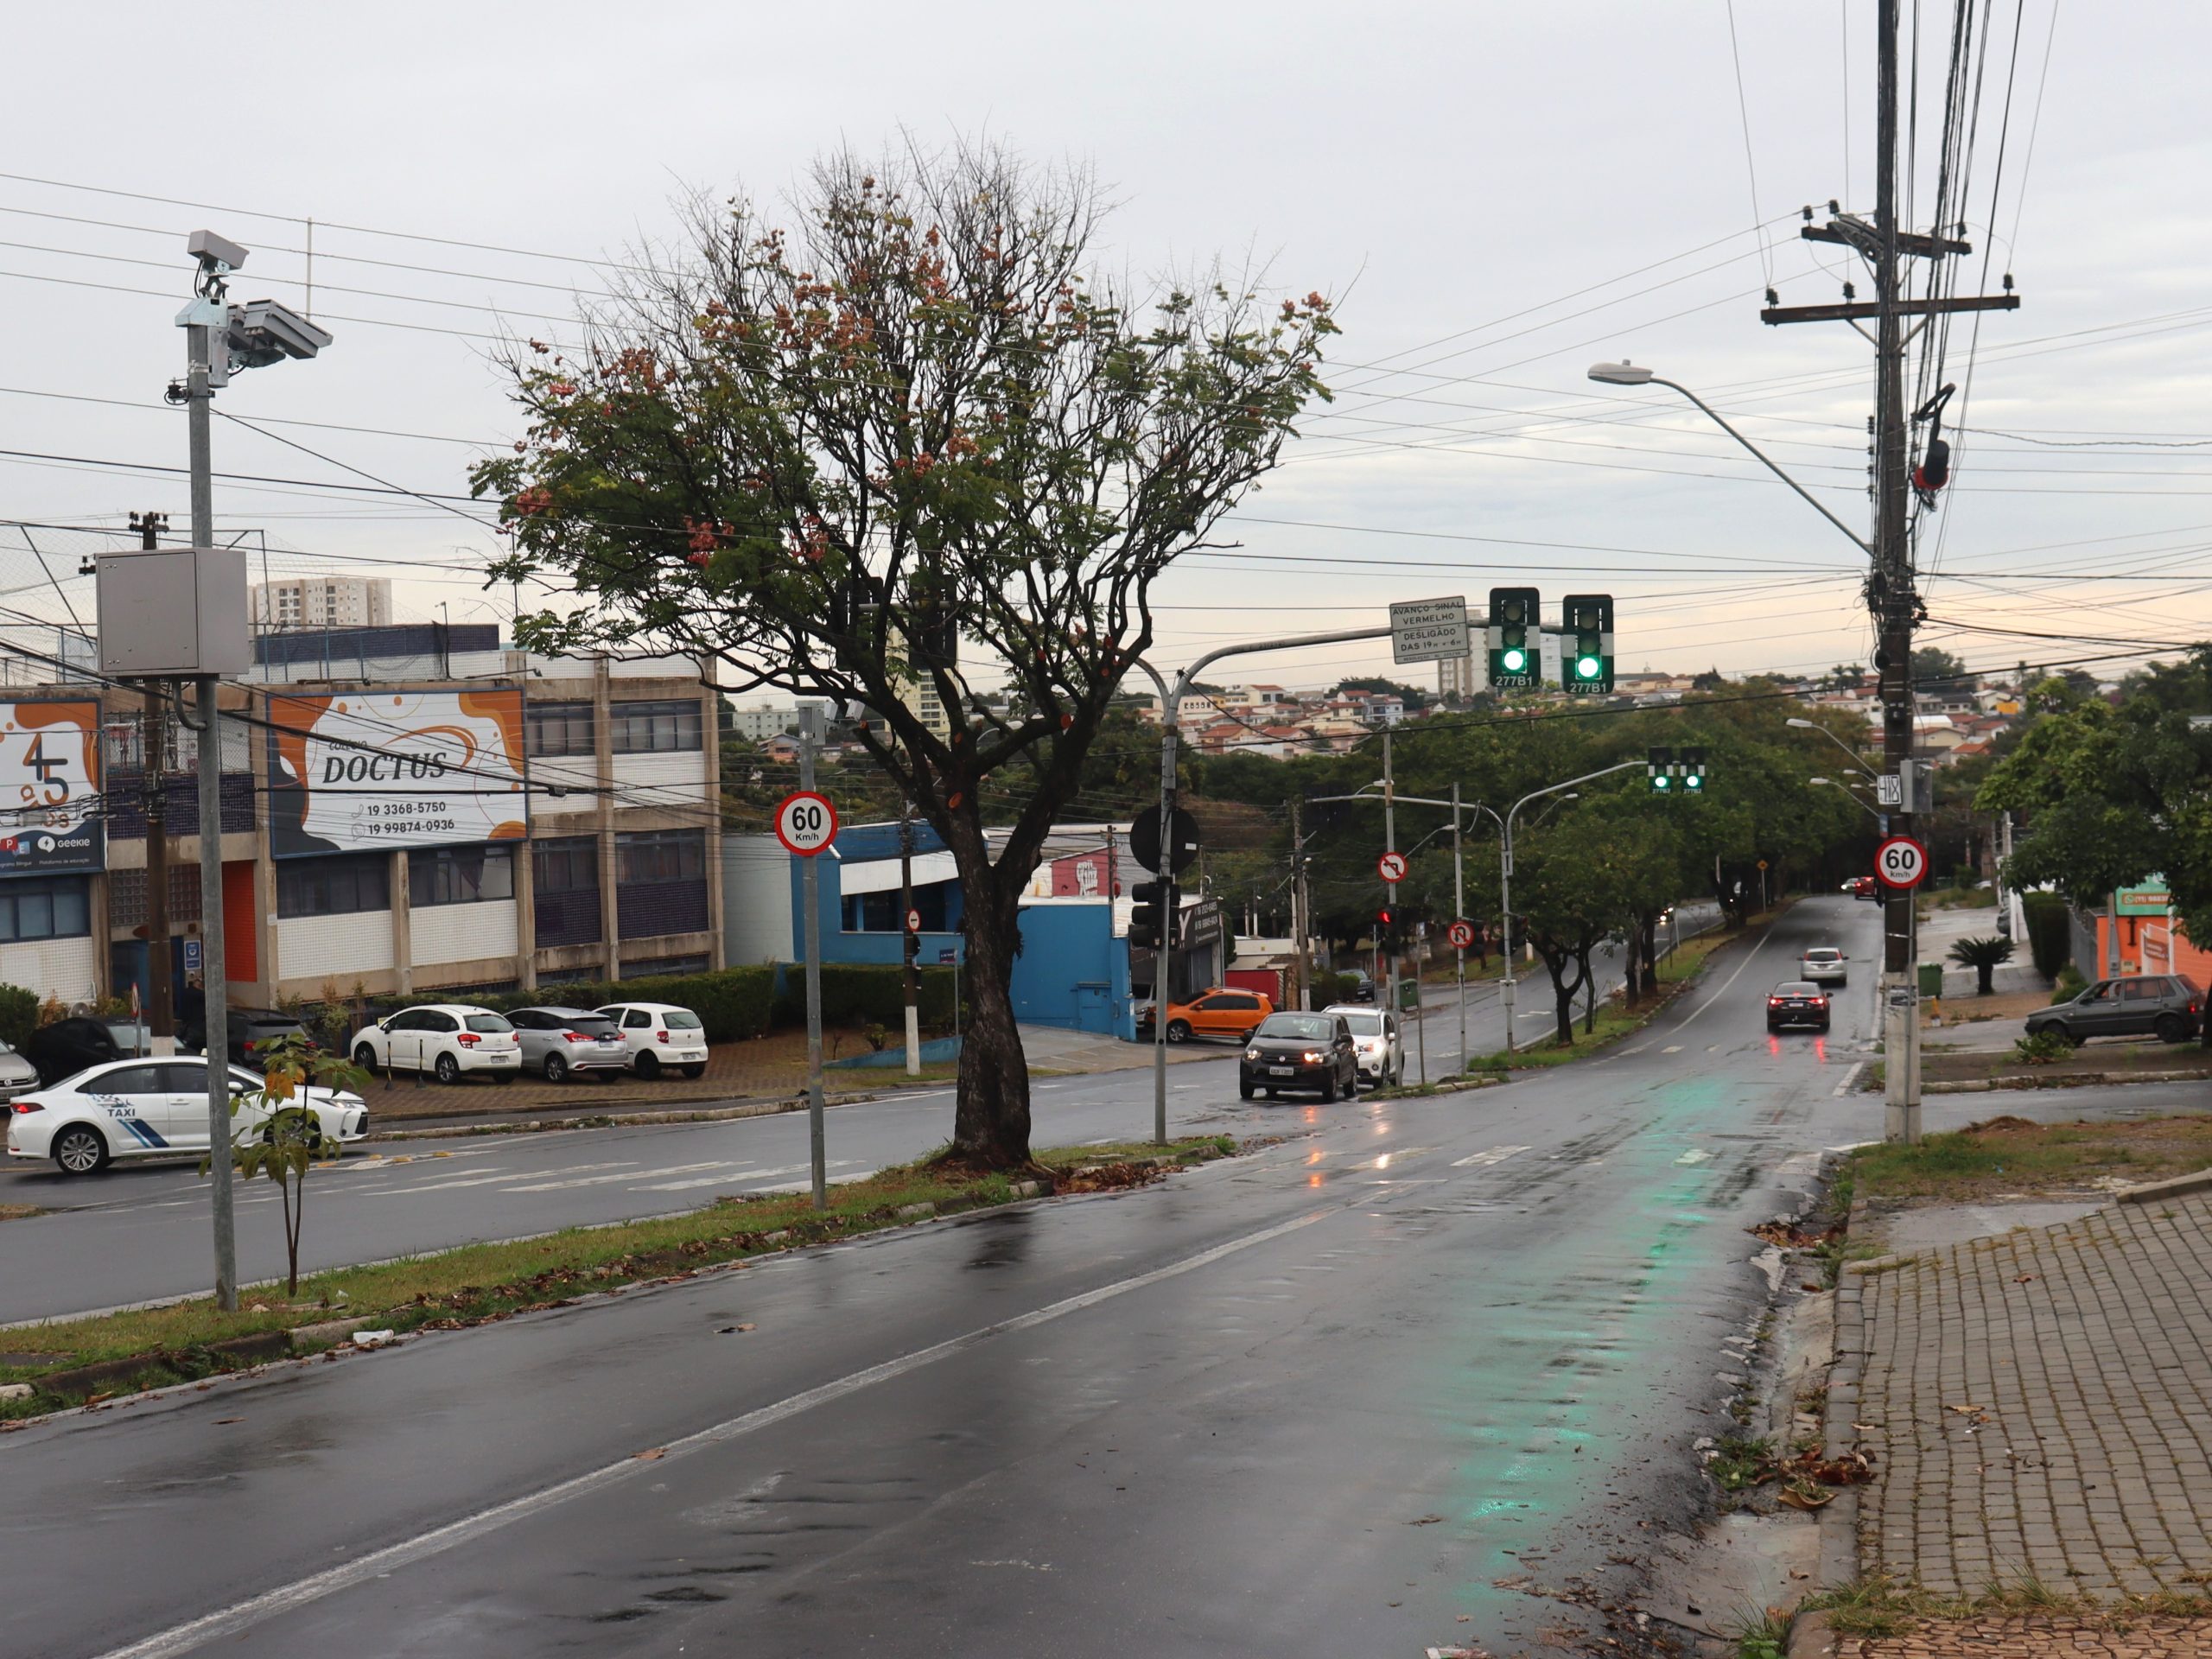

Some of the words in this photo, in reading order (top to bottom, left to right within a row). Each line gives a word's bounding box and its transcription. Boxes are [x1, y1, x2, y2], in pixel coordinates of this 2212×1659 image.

[1393, 606, 1429, 615] AVANÇO
[1435, 601, 1463, 610] SINAL
[1403, 613, 1455, 625] VERMELHO
[1404, 628, 1457, 640] DESLIGADO
[1401, 642, 1420, 652] DAS
[1496, 676, 1533, 686] 277B1
[1570, 683, 1607, 693] 277B1
[322, 752, 447, 784] DOCTUS
[367, 804, 380, 817] 19
[384, 802, 447, 816] 3368-5750
[791, 805, 822, 831] 60
[368, 823, 381, 836] 19
[385, 818, 455, 835] 99874-0936
[795, 832, 819, 842] Km/h
[1885, 849, 1916, 870] 60
[107, 1109, 136, 1117] TAXI
